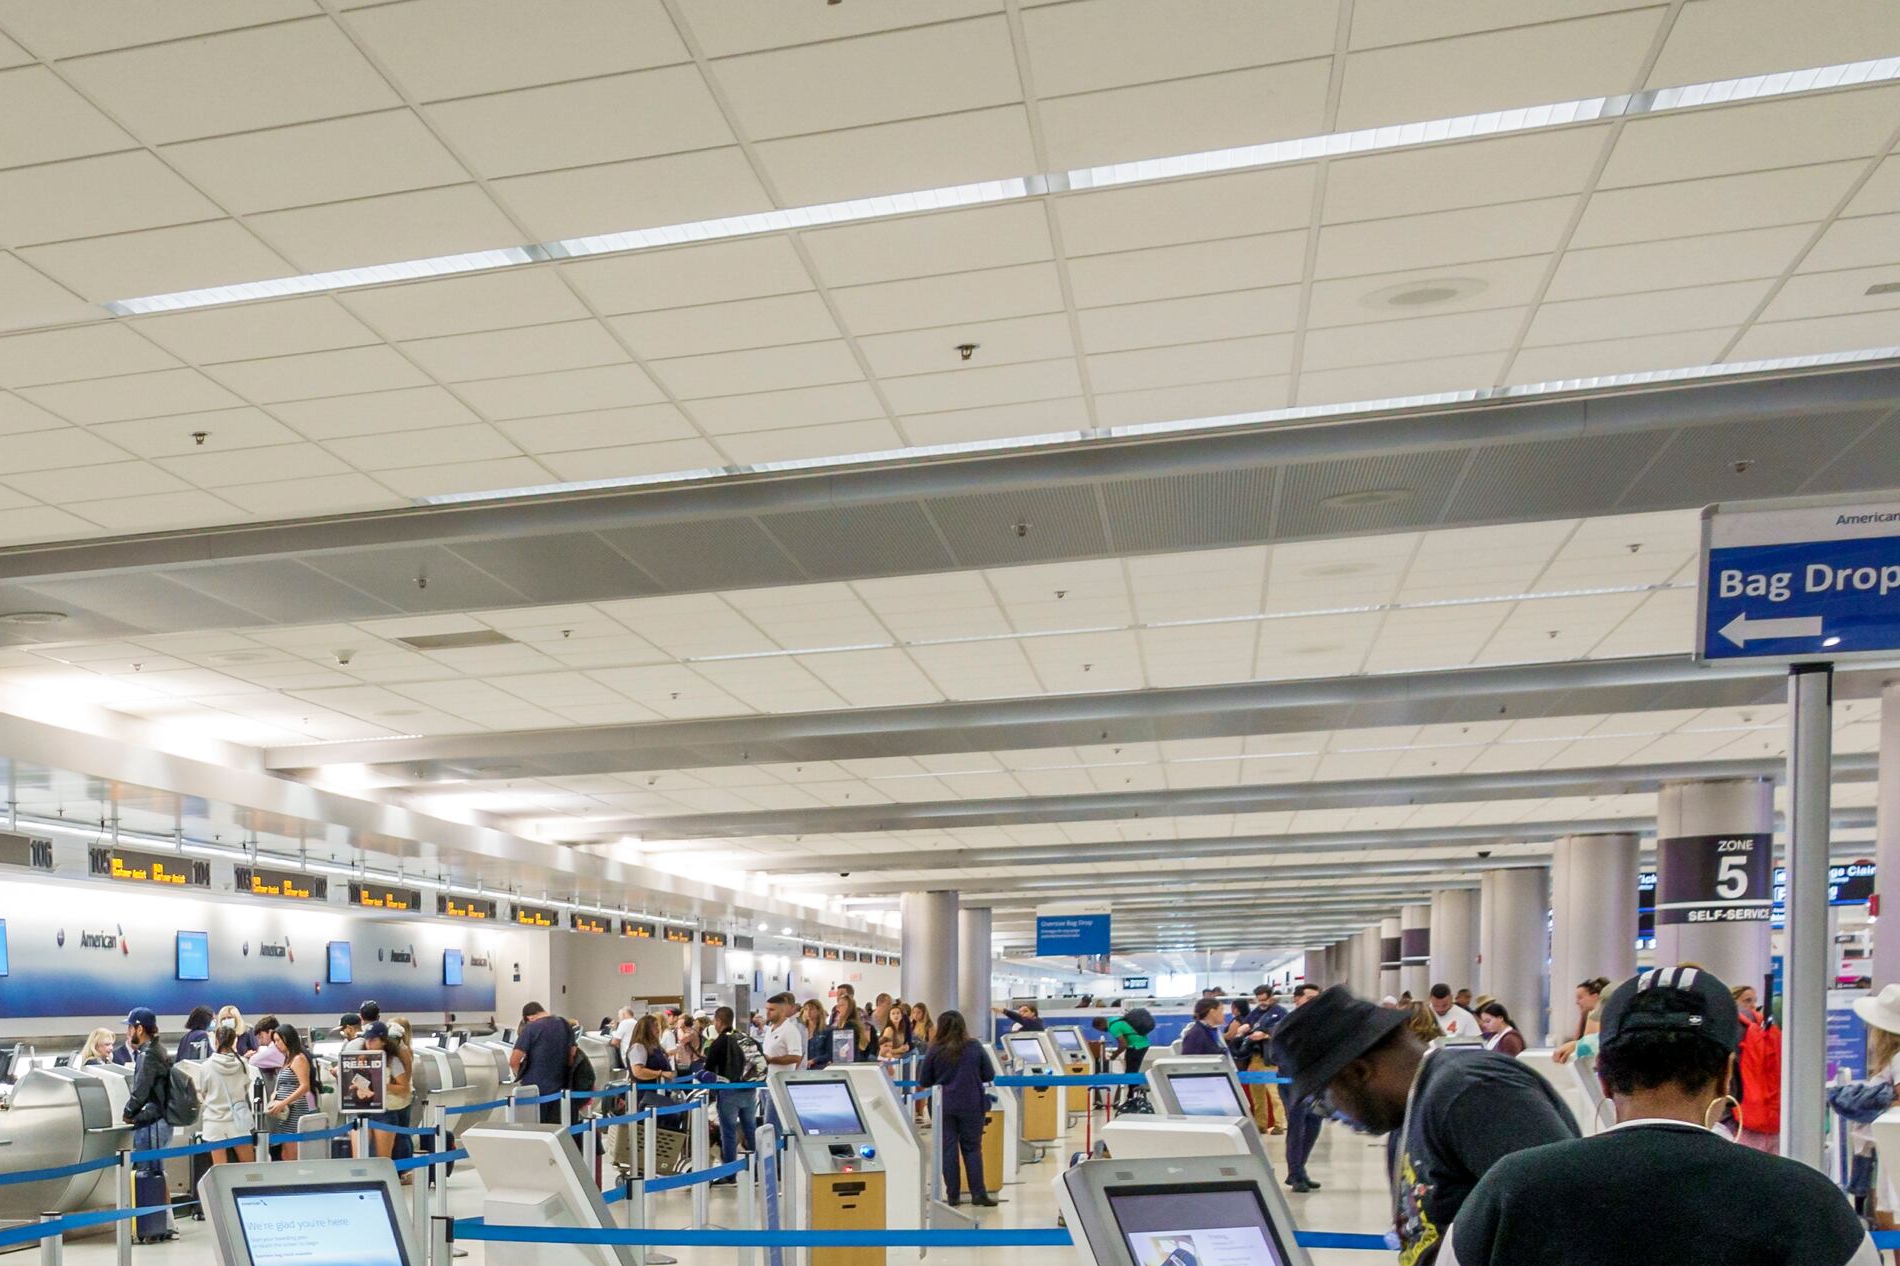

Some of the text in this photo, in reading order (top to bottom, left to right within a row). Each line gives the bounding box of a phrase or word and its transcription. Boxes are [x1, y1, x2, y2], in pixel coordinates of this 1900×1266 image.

[1836, 512, 1900, 526] American
[1719, 563, 1900, 602] Bag Drop
[1717, 839, 1754, 852] ZONE
[1716, 855, 1748, 899] 5
[1688, 908, 1770, 922] SELF-SERVICE
[80, 928, 117, 949] American
[276, 1220, 295, 1232] glad
[327, 1217, 349, 1227] here
